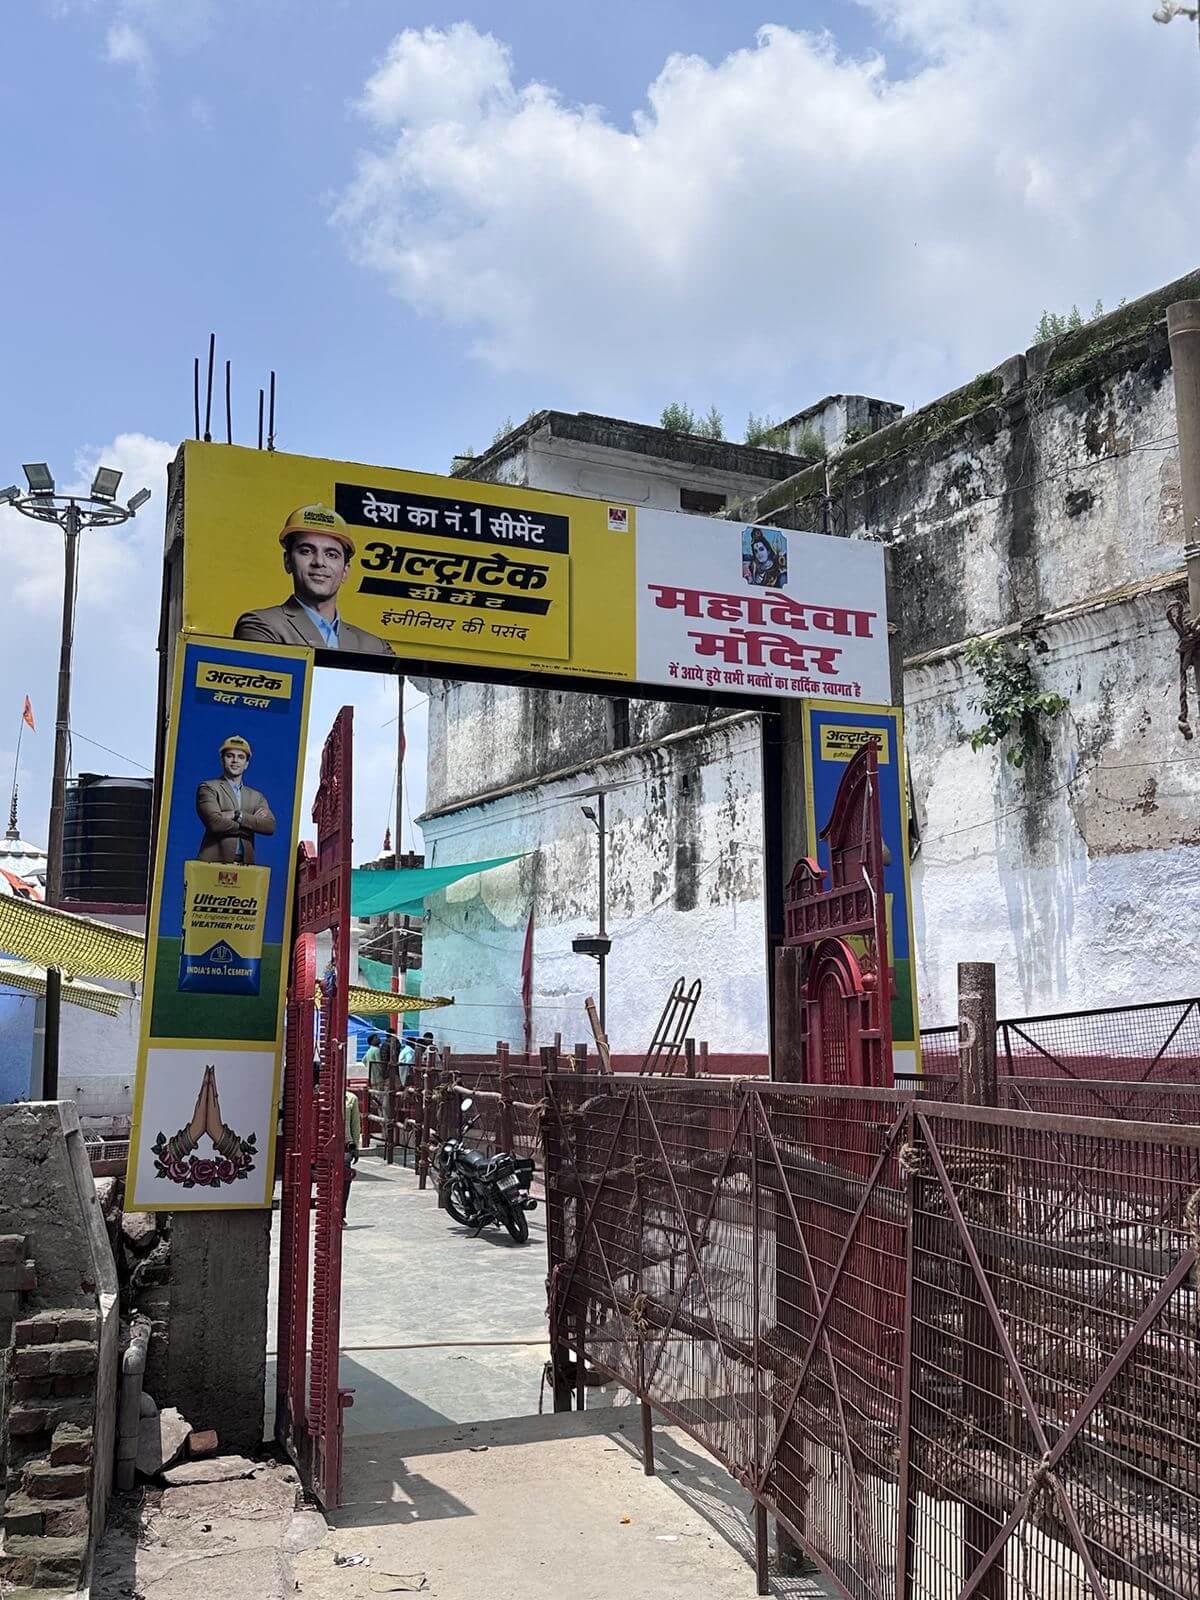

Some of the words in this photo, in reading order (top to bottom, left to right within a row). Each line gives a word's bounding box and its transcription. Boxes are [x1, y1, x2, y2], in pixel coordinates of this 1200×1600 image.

[362, 492, 400, 523] देश
[407, 506, 438, 529] का
[489, 512, 546, 544] सीमेंट
[360, 542, 549, 590] अल्ट्राटेक
[380, 608, 456, 631] इंजीनियर
[462, 617, 485, 635] की
[491, 623, 529, 641] पसंद
[647, 584, 878, 638] महादेवा
[687, 627, 843, 675] मंदिर
[205, 670, 282, 690] अल्ट्राटेक
[668, 662, 680, 678] में
[681, 665, 704, 681] आये
[706, 667, 721, 686] हुये
[723, 669, 744, 685] सभी
[747, 671, 773, 689] भक्तों
[775, 676, 789, 690] का
[790, 676, 820, 693] हार्दिक
[822, 682, 852, 697] स्वागत
[852, 682, 862, 697] है
[213, 691, 239, 705] वेदर
[242, 697, 271, 708] प्लस
[193, 894, 258, 908] UltraTech
[191, 921, 233, 930] WEATHER
[234, 923, 256, 931] PLUS
[186, 966, 210, 975] INDIA'S
